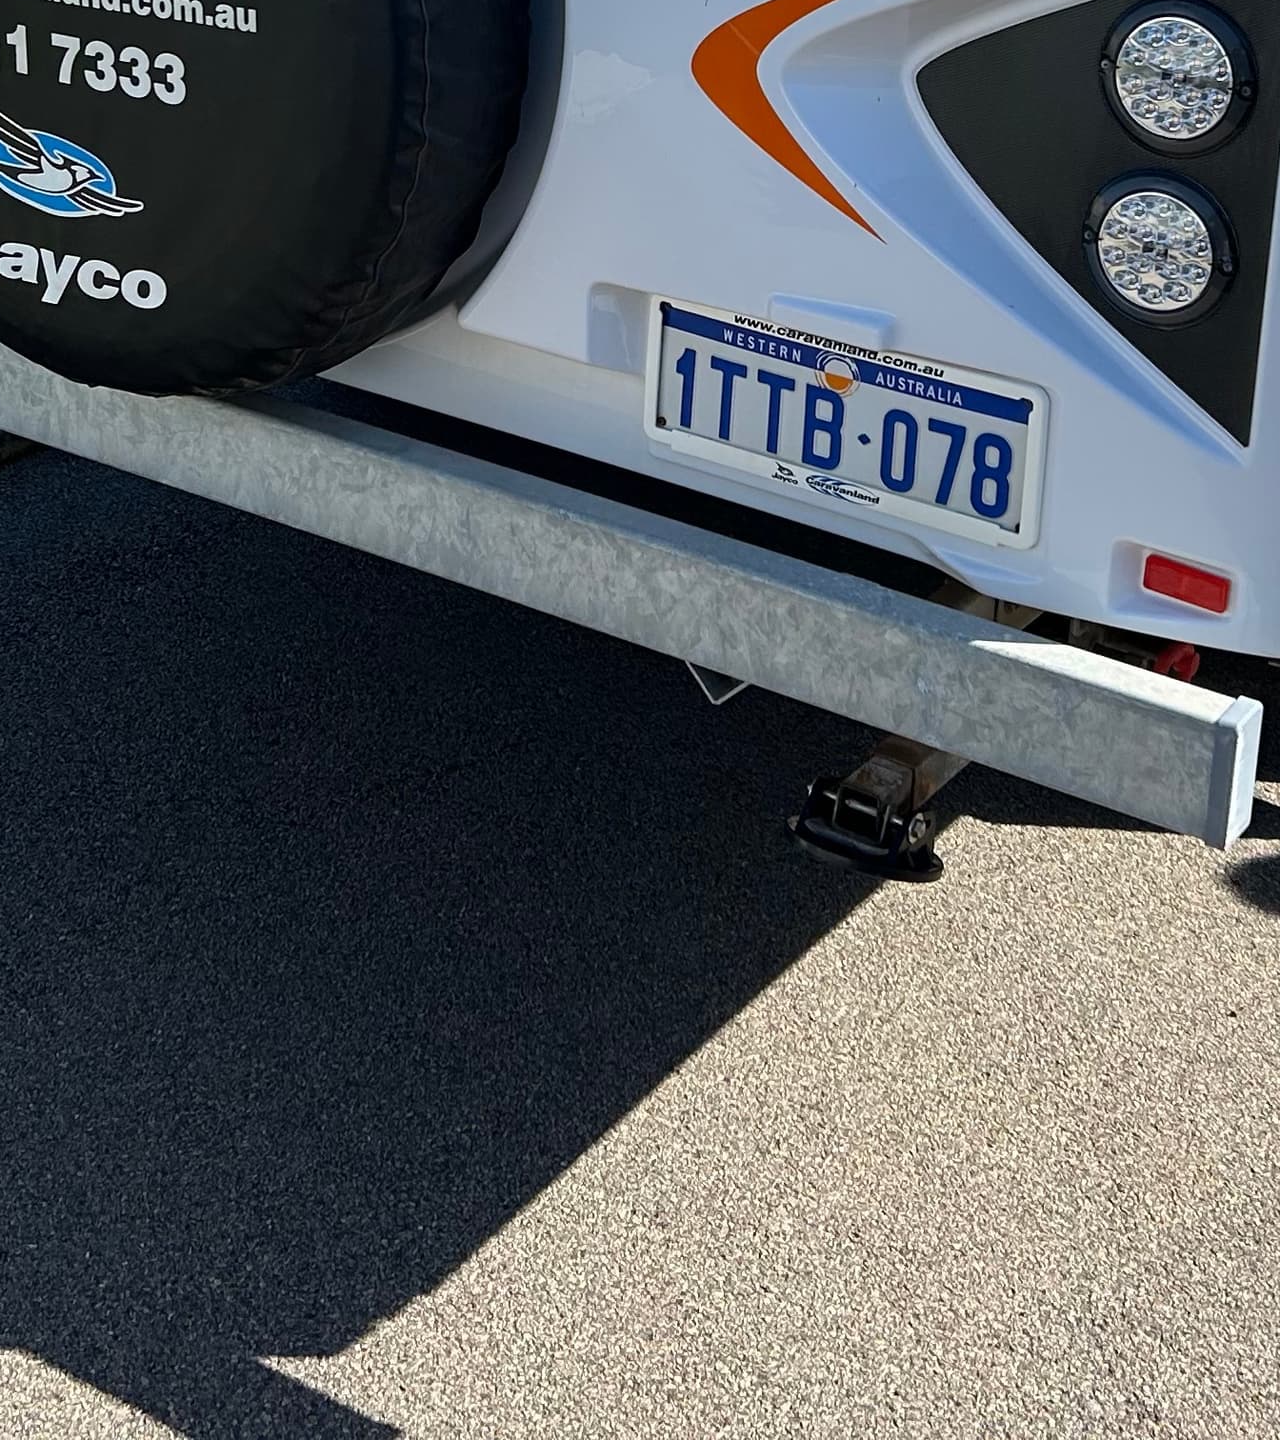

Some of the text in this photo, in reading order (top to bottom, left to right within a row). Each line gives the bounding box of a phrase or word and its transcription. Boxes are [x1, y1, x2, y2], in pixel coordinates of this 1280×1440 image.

[50, 32, 187, 106] 7333
[722, 327, 802, 364] WESTERN
[733, 314, 945, 379] www.caravanland.com.au
[875, 370, 964, 406] AUSTRALIA
[771, 472, 799, 486] Jayco
[805, 475, 880, 505] Caravanland
